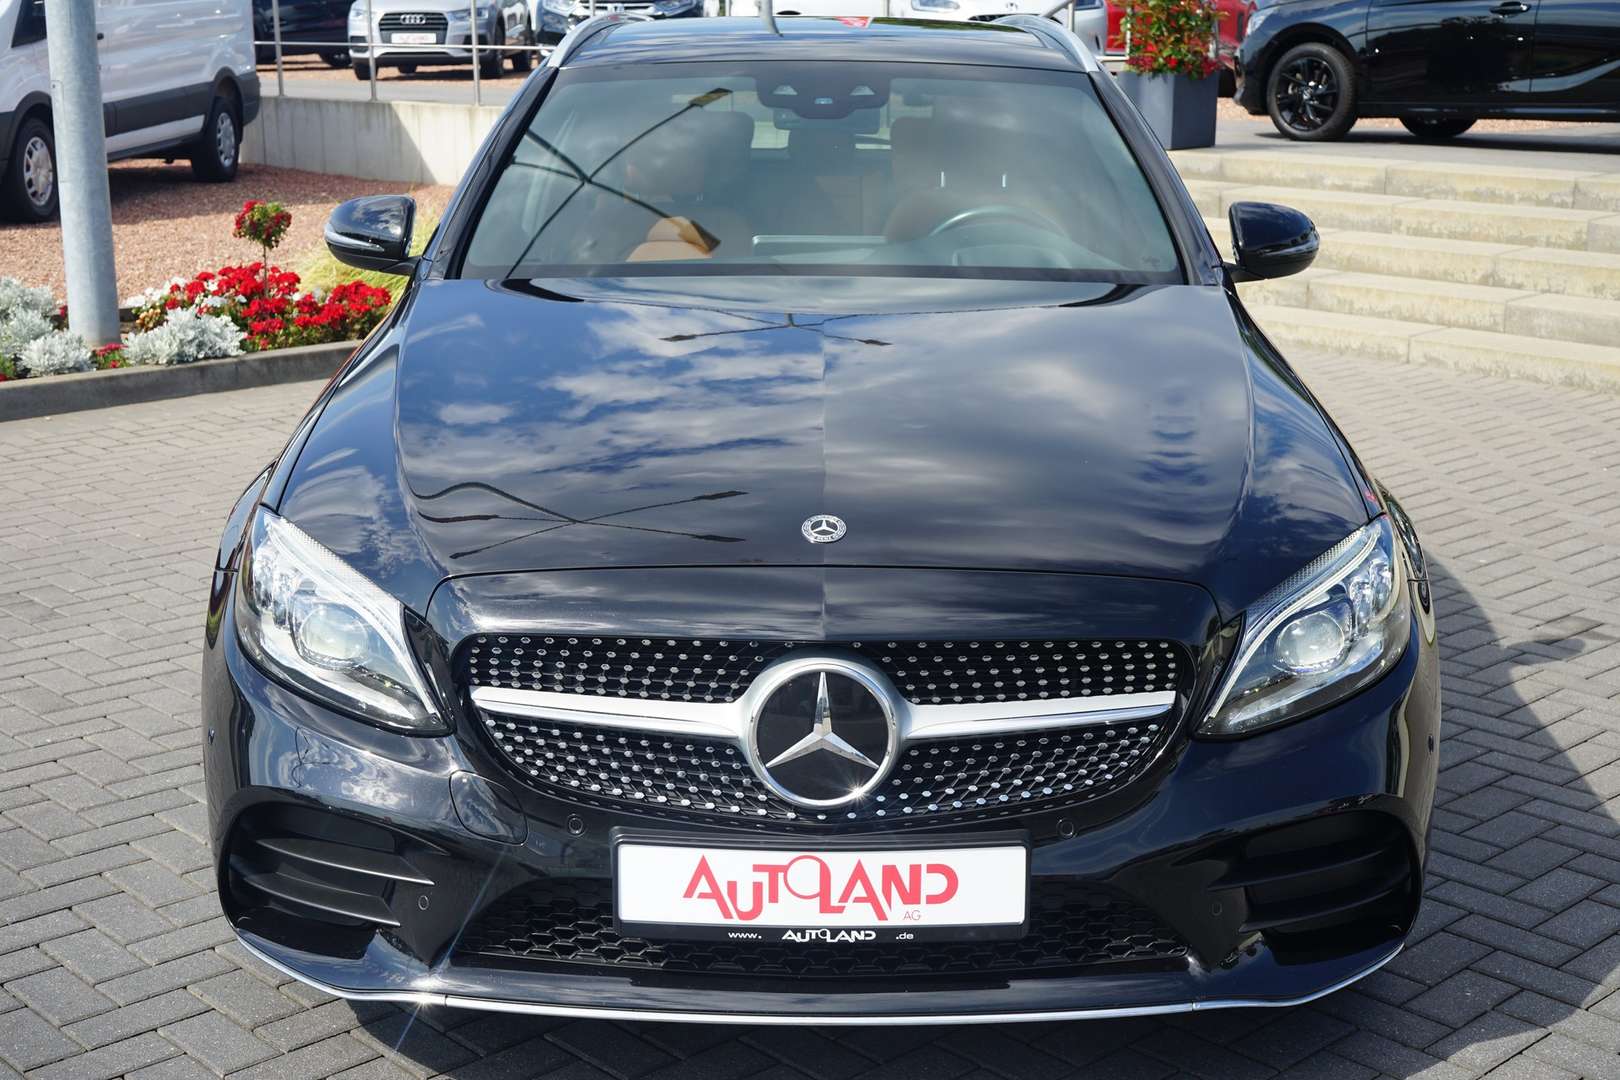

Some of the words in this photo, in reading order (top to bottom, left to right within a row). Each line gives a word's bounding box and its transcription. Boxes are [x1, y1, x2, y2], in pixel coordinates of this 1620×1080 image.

[902, 909, 922, 921] AG
[727, 932, 762, 940] www.
[895, 931, 914, 940] .de
